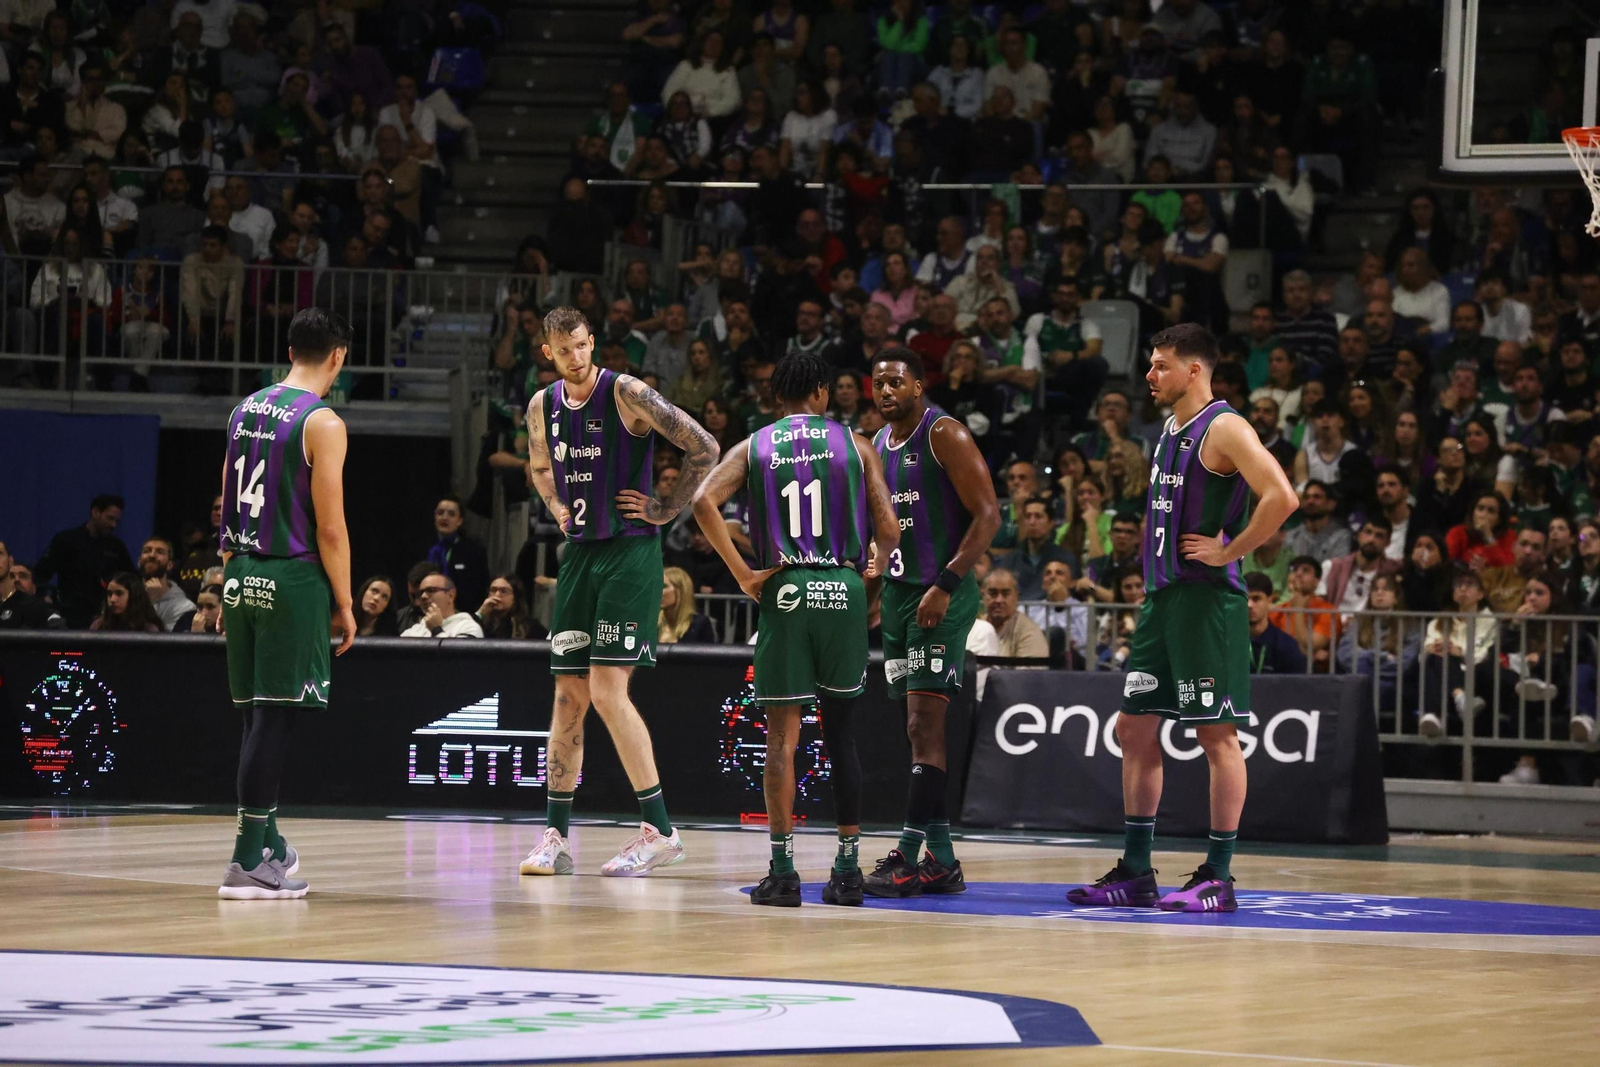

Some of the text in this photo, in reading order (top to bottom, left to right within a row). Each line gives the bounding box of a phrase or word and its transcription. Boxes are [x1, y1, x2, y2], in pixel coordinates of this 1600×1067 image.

[771, 423, 830, 445] Carter
[234, 454, 266, 518] 14
[890, 488, 920, 506] nicaja
[573, 498, 587, 526] 2
[781, 478, 823, 538] 11
[1155, 527, 1165, 558] 7
[778, 549, 840, 566] Andalucía
[889, 547, 905, 577] 3
[243, 576, 276, 591] COSTA
[806, 581, 848, 592] COSTA
[243, 588, 275, 601] DEL SOL
[806, 592, 848, 601] DEL SOL
[806, 601, 848, 610] MÁLAGA
[408, 742, 582, 788] LOTU
